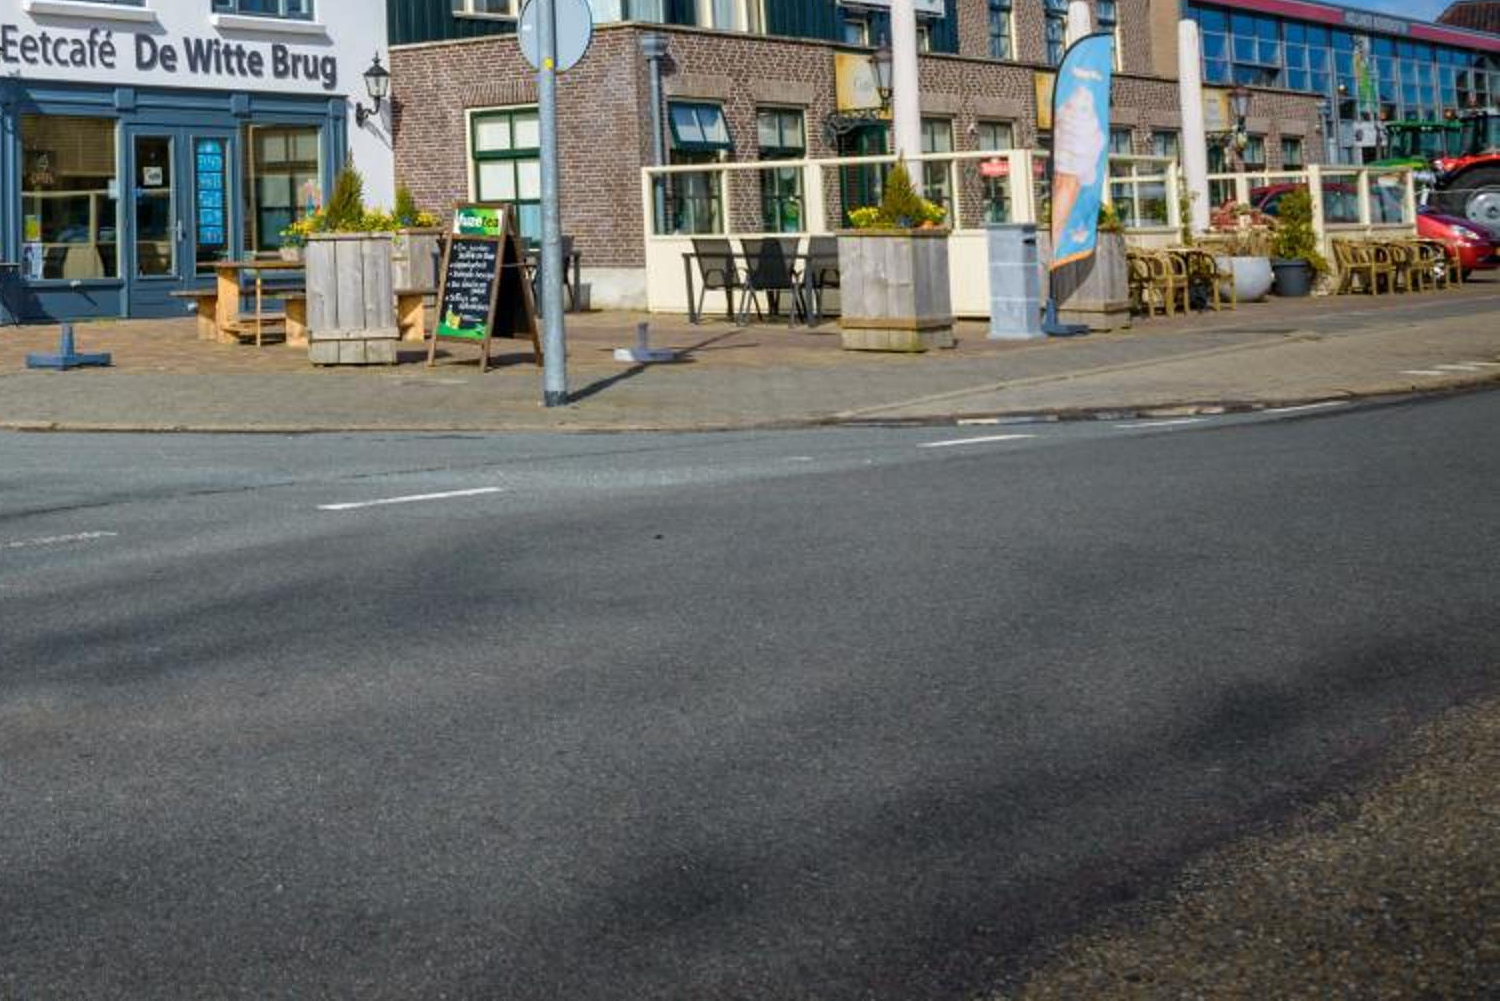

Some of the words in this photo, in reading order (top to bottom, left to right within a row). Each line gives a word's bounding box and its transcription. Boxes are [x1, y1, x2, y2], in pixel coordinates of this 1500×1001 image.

[1, 23, 116, 69] Eetcafé
[134, 33, 177, 73] De
[183, 36, 264, 78] Witte
[271, 44, 337, 90] Brug
